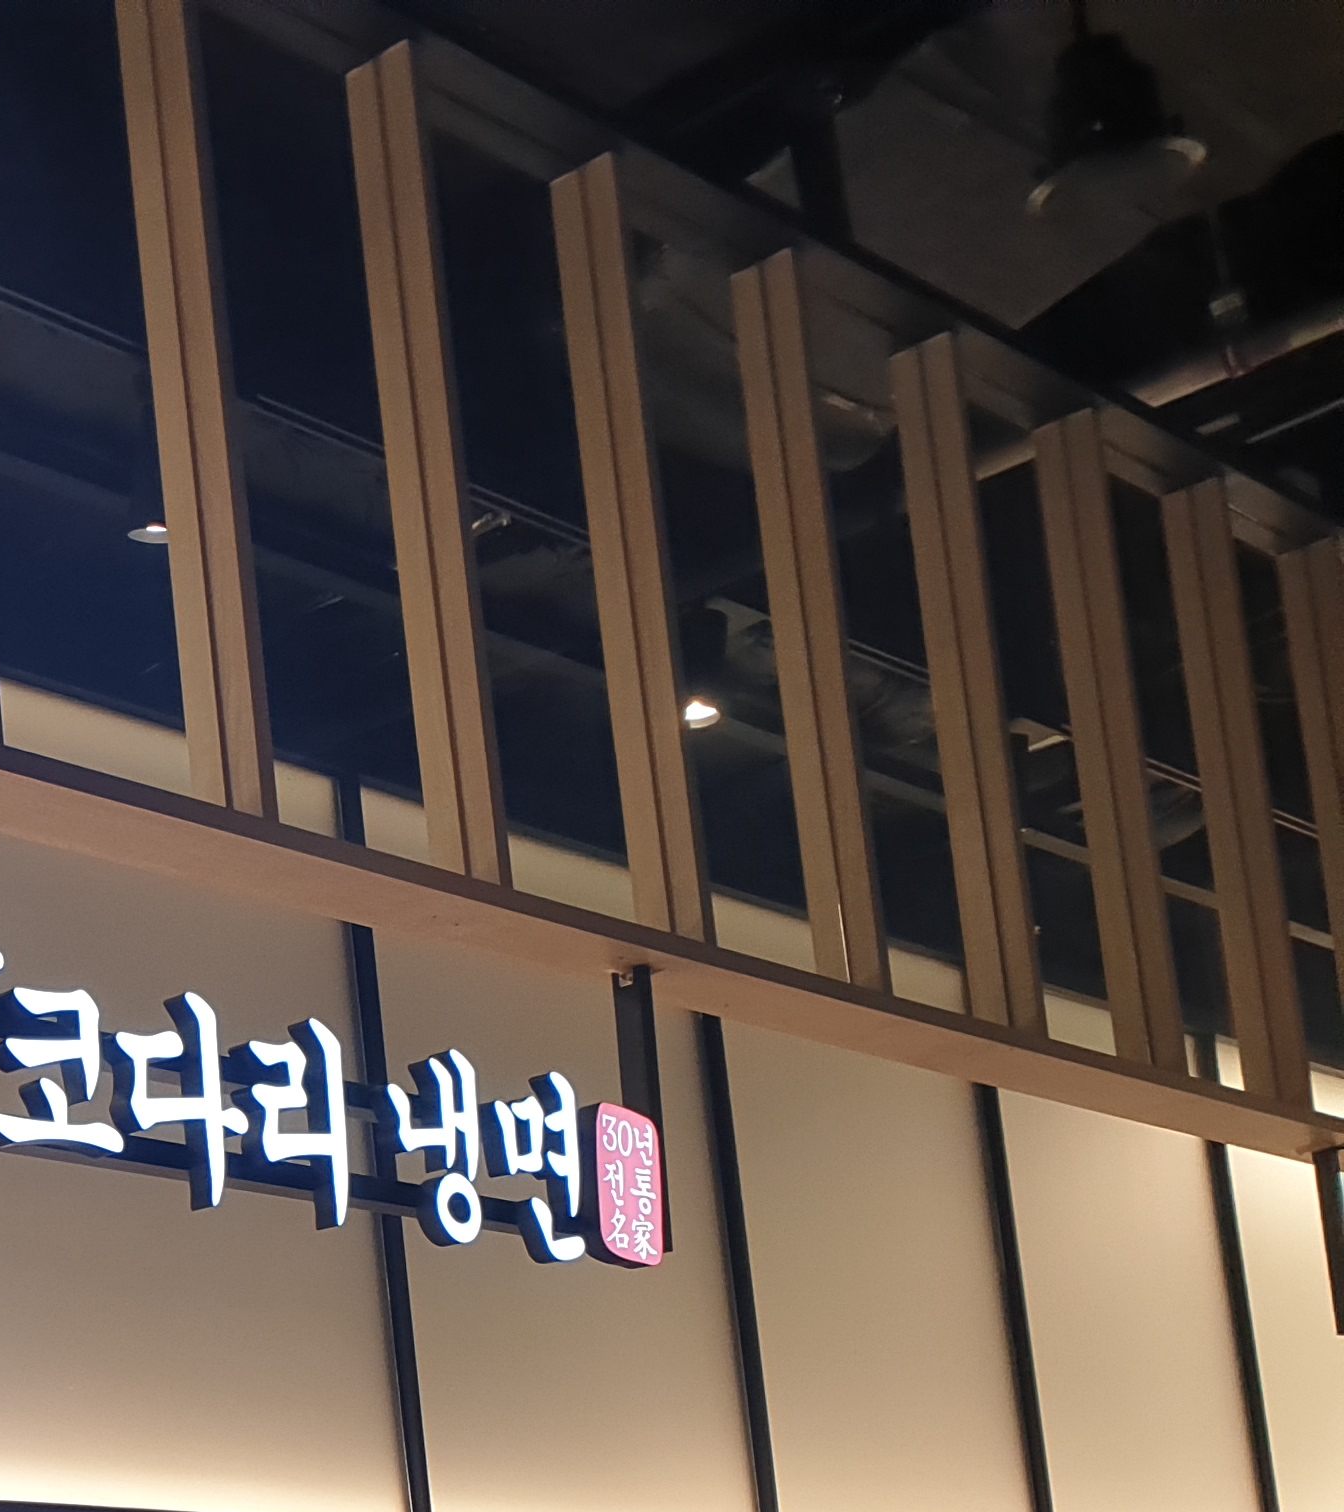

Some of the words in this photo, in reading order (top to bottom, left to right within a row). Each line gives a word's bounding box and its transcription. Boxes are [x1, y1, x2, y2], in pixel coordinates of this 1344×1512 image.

[388, 1049, 585, 1261] 냉면
[602, 1113, 653, 1167] 30년
[602, 1159, 657, 1216] 전통
[606, 1207, 658, 1261] 名家
